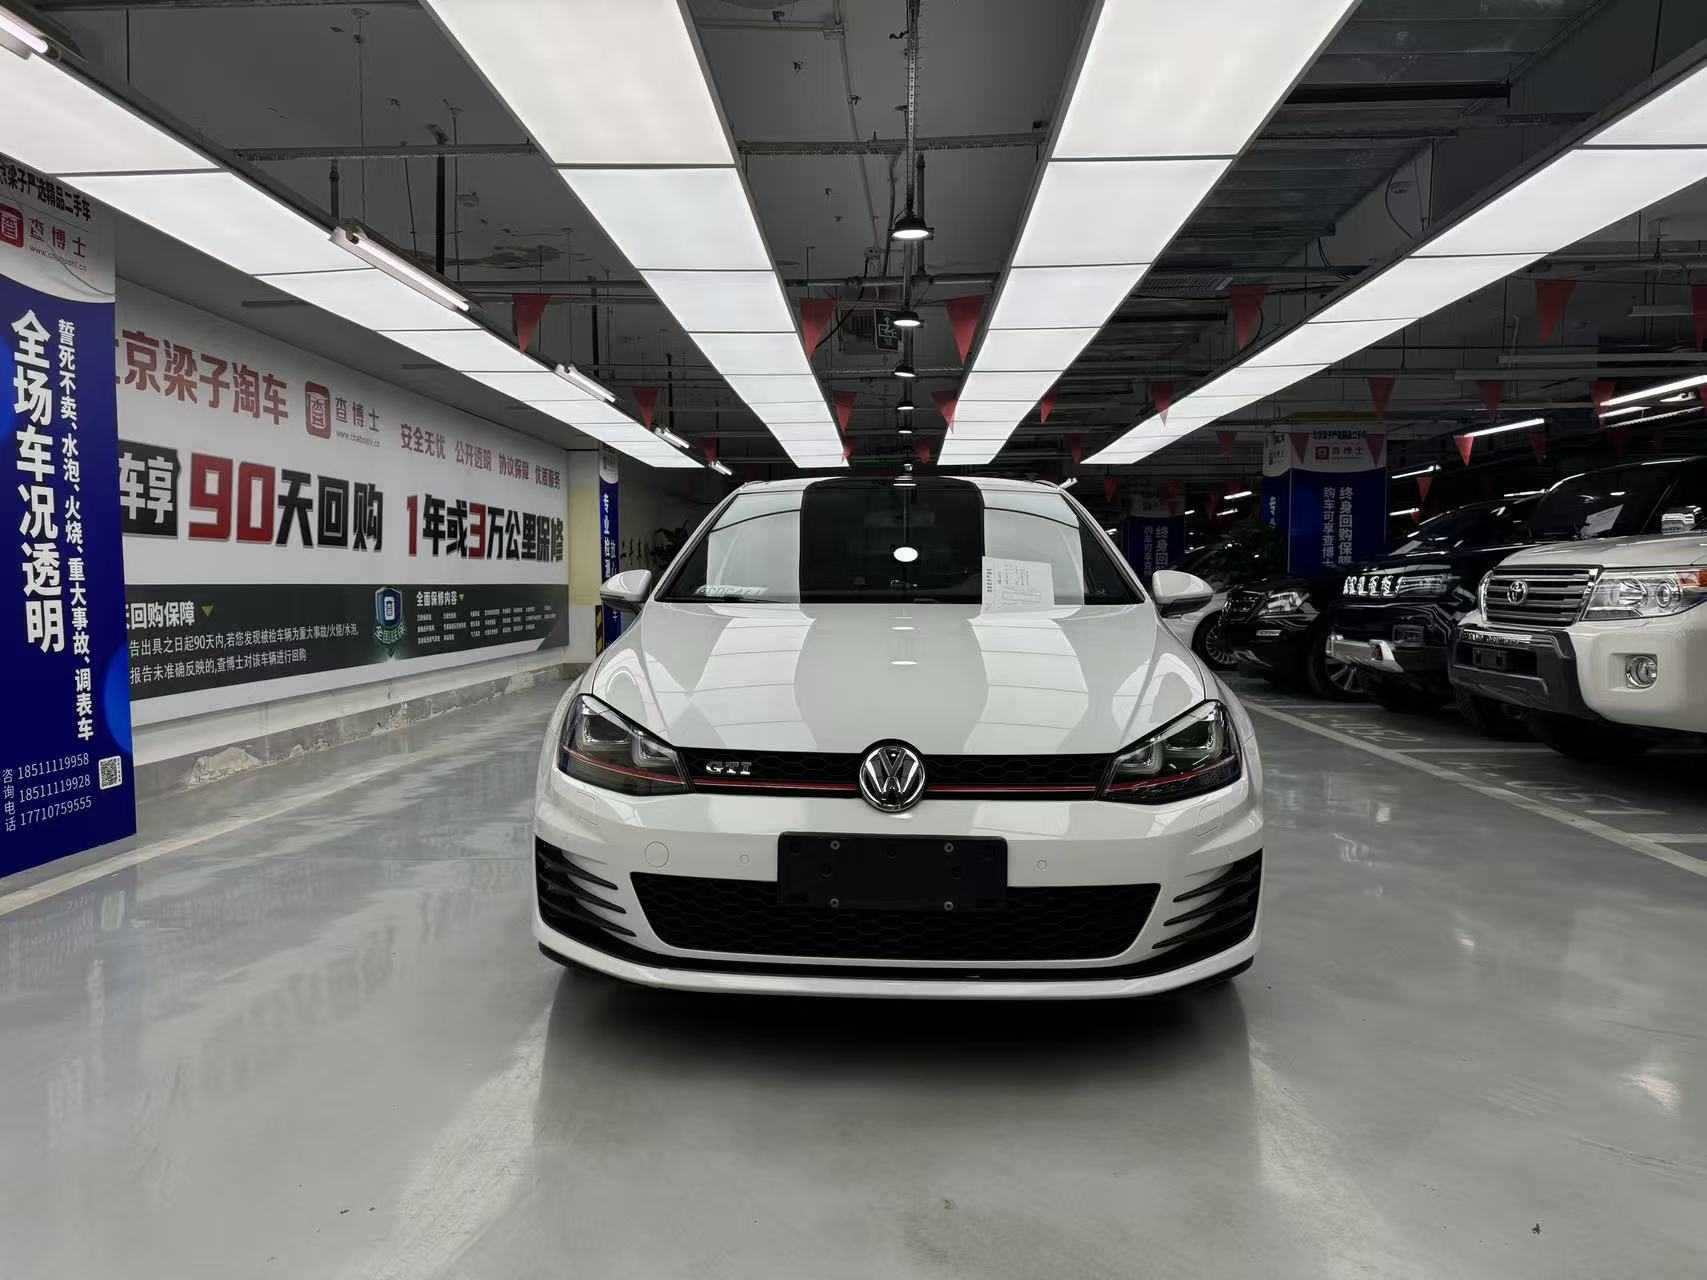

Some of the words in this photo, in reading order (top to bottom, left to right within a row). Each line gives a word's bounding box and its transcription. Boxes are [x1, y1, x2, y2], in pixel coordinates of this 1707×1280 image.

[28, 217, 87, 258] 查博士
[115, 329, 289, 425] 京梁子淘车
[335, 397, 380, 432] 查博士
[401, 424, 446, 459] 安全无忧
[11, 310, 65, 653] 全场车况透明
[58, 319, 94, 741] 誓死不卖、水泡、火烧、重大事故、调表车
[407, 494, 564, 563] 1年或3万公里保修
[126, 601, 195, 629] 回购保障
[18, 753, 90, 780] 18511119958
[705, 760, 752, 776] GTI
[2, 768, 16, 833] 咨询电话
[19, 774, 91, 803] 18511119928
[20, 796, 92, 827] 17710759555
